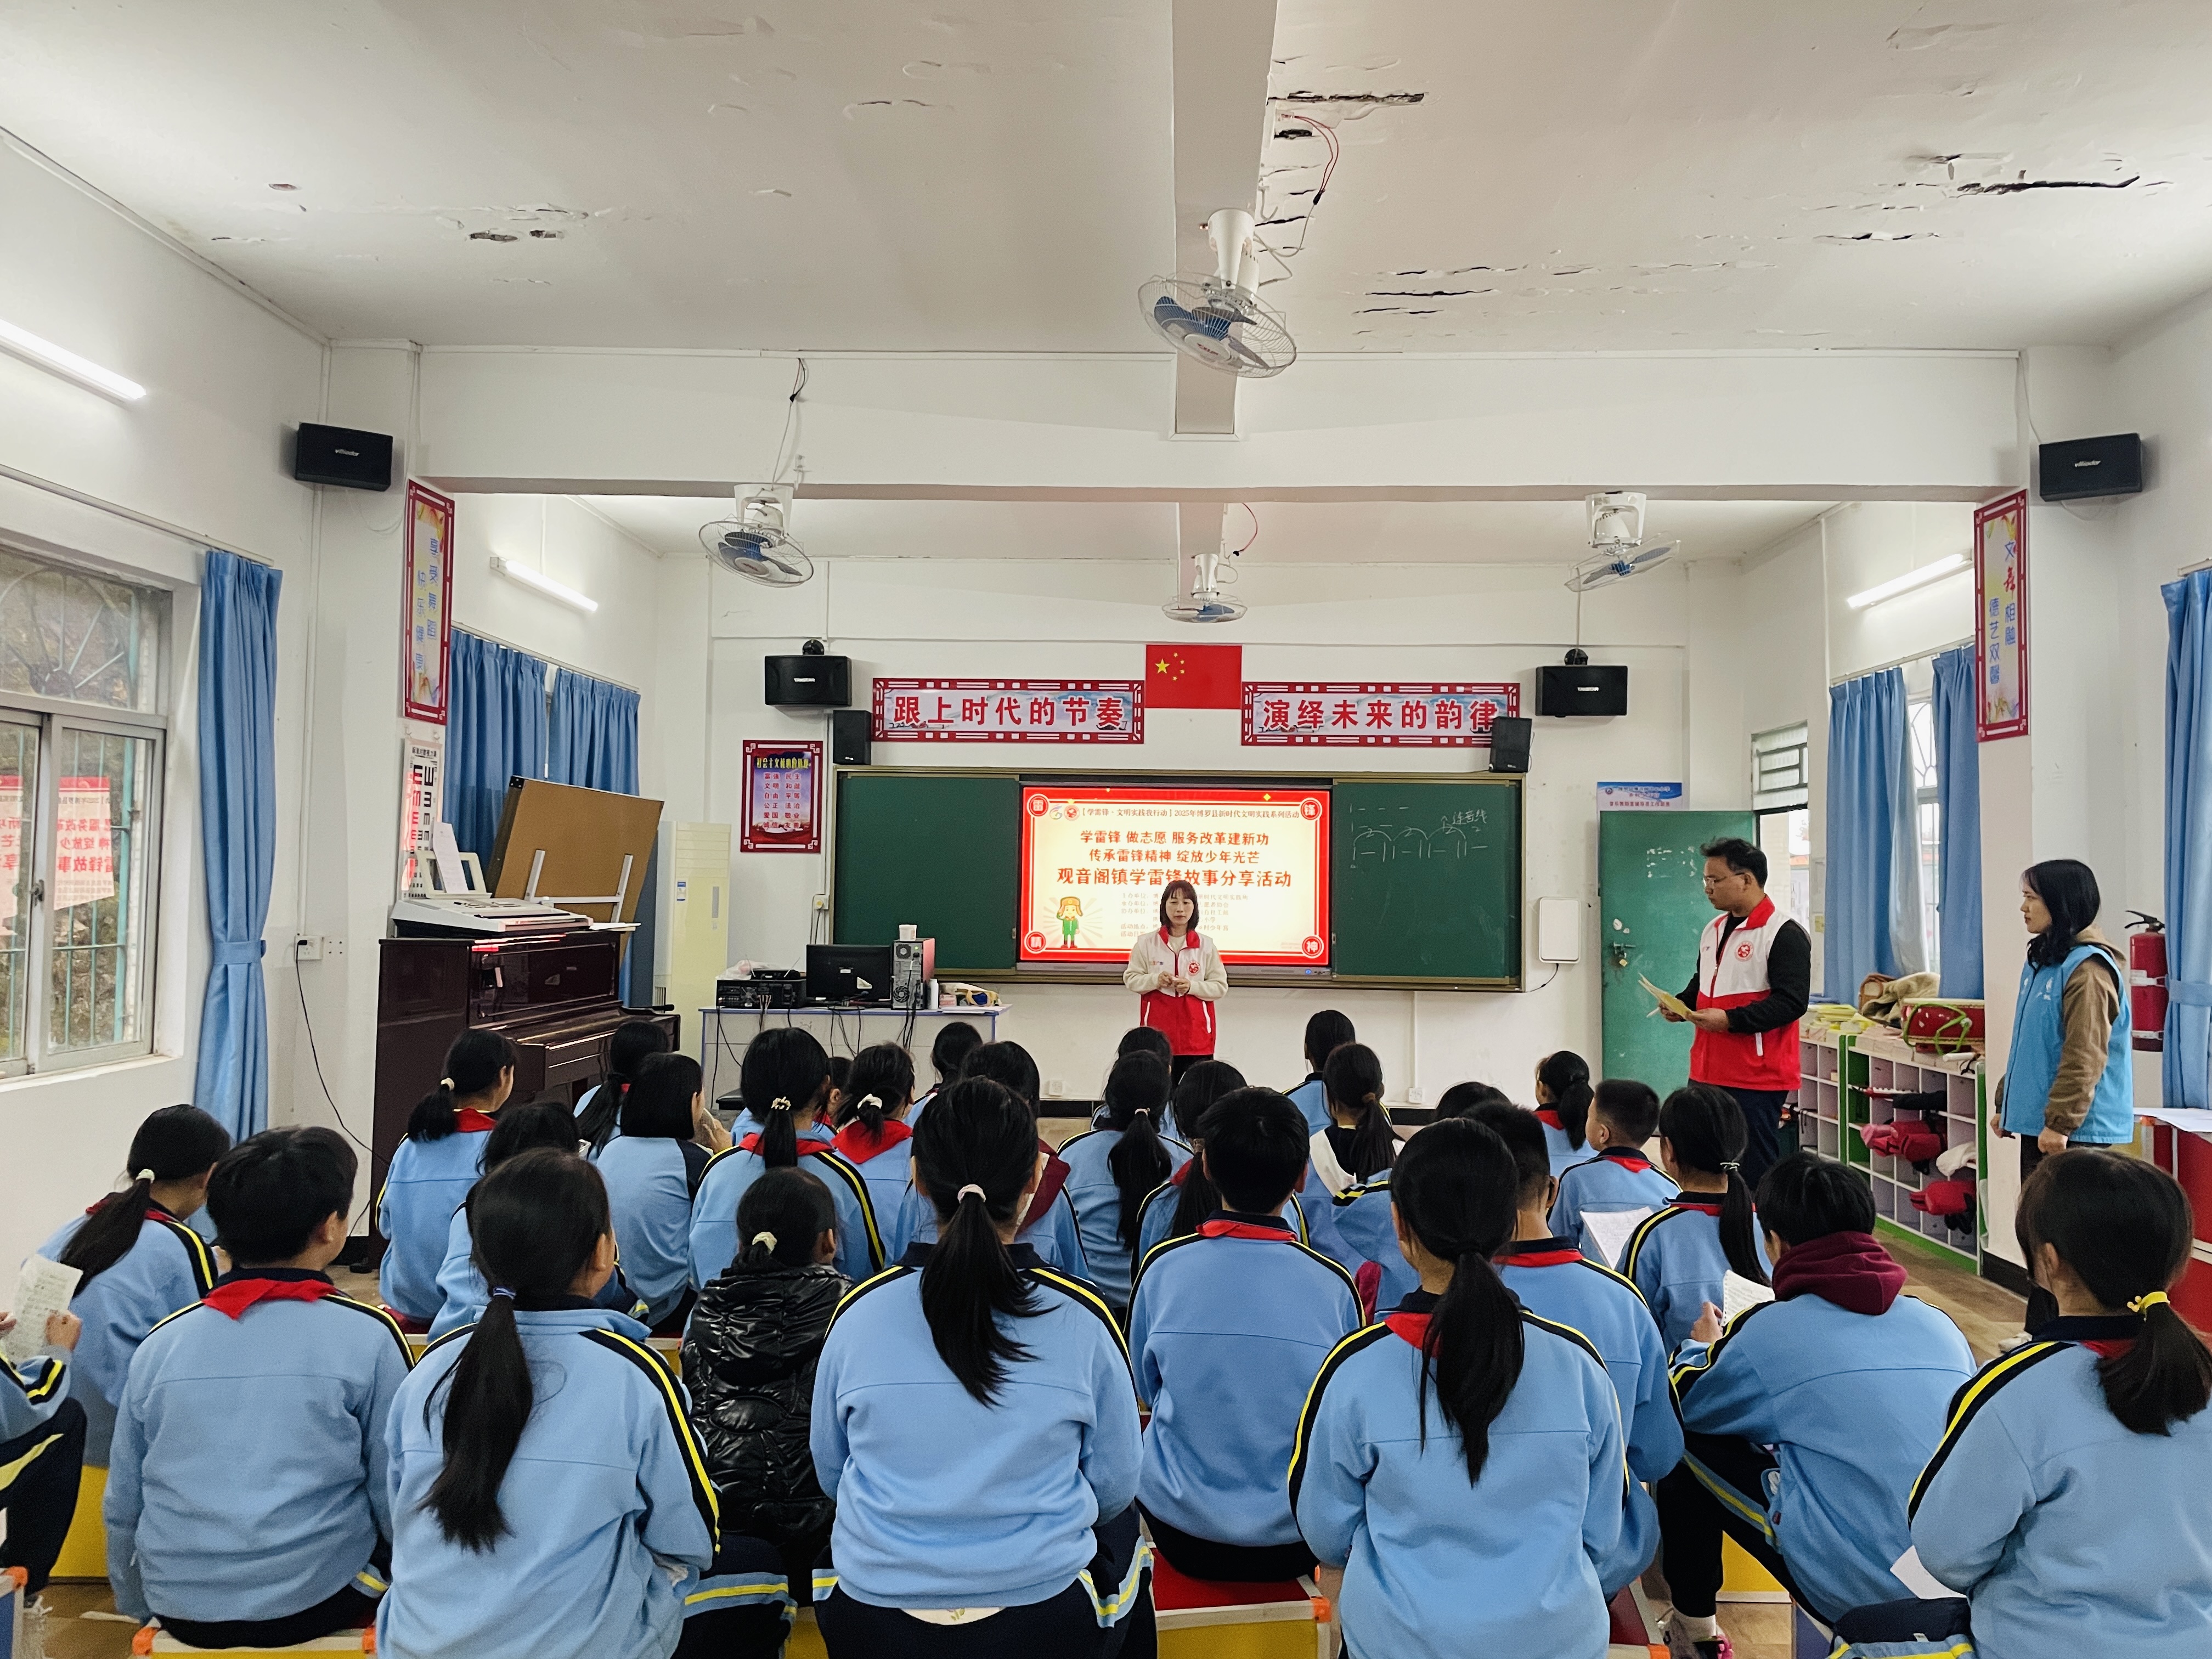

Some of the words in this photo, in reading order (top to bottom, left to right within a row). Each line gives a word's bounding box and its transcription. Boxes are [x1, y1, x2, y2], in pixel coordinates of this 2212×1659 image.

[893, 696, 1124, 727] 跟上时代的节奏
[1263, 699, 1498, 729] 演绎未来的韵律
[1080, 830, 1121, 843] 学雷锋
[1126, 831, 1167, 844] 做志愿
[1172, 831, 1269, 845] 服务改革建新功
[1089, 849, 1171, 862] 传承雷锋精神
[1177, 850, 1260, 864] 绽放少年光芒
[1057, 867, 1291, 888] 观音阁镇学雷锋故事分享活动
